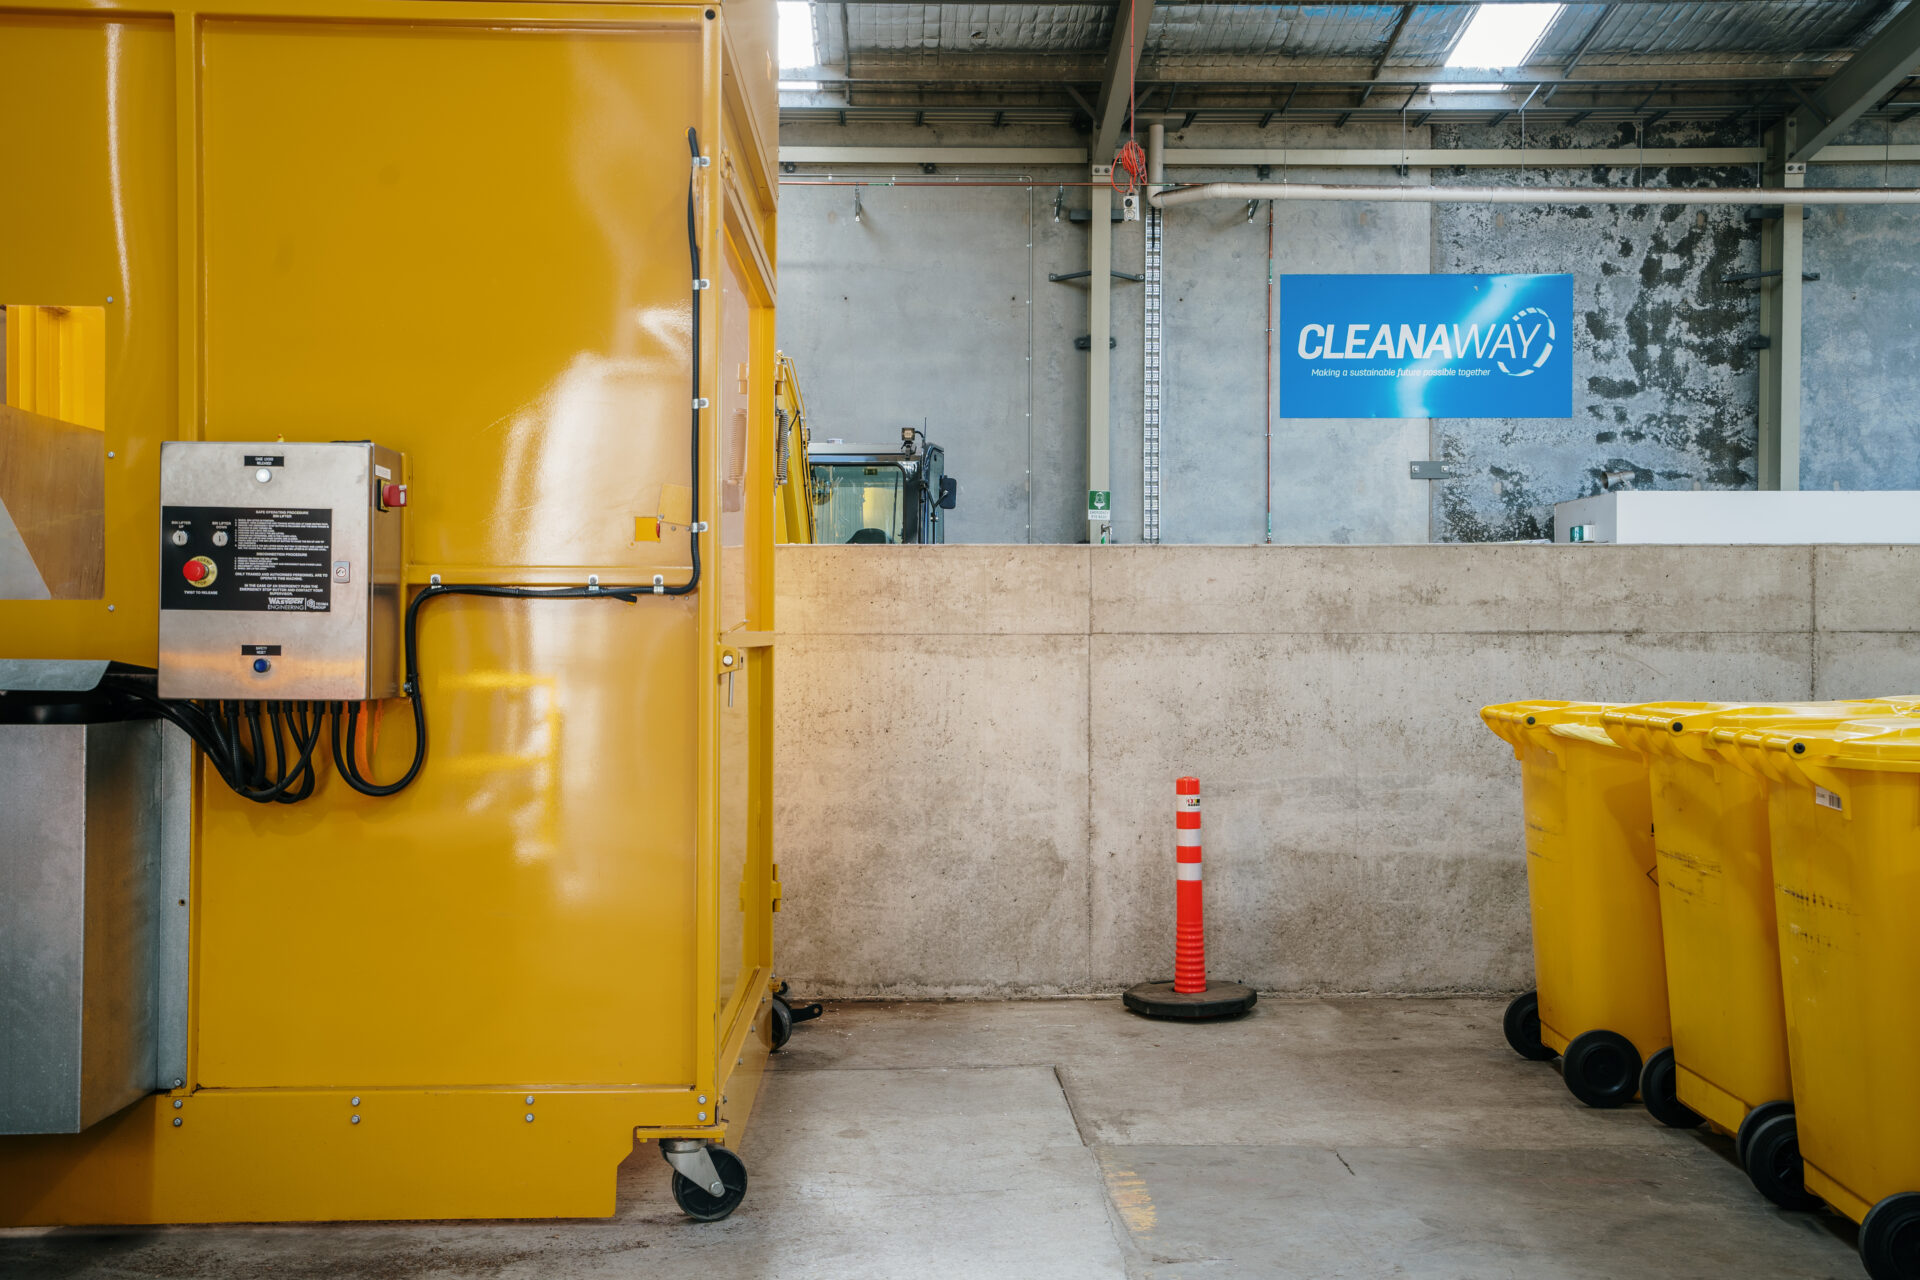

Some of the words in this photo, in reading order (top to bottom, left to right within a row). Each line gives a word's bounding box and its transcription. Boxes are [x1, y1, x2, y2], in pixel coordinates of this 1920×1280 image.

[1297, 323, 1542, 360] CLEANAWAY
[1311, 368, 1340, 378] Making
[1349, 368, 1395, 377] sustainable
[1397, 368, 1421, 378] future
[1423, 368, 1456, 378] possible
[1458, 368, 1491, 378] together
